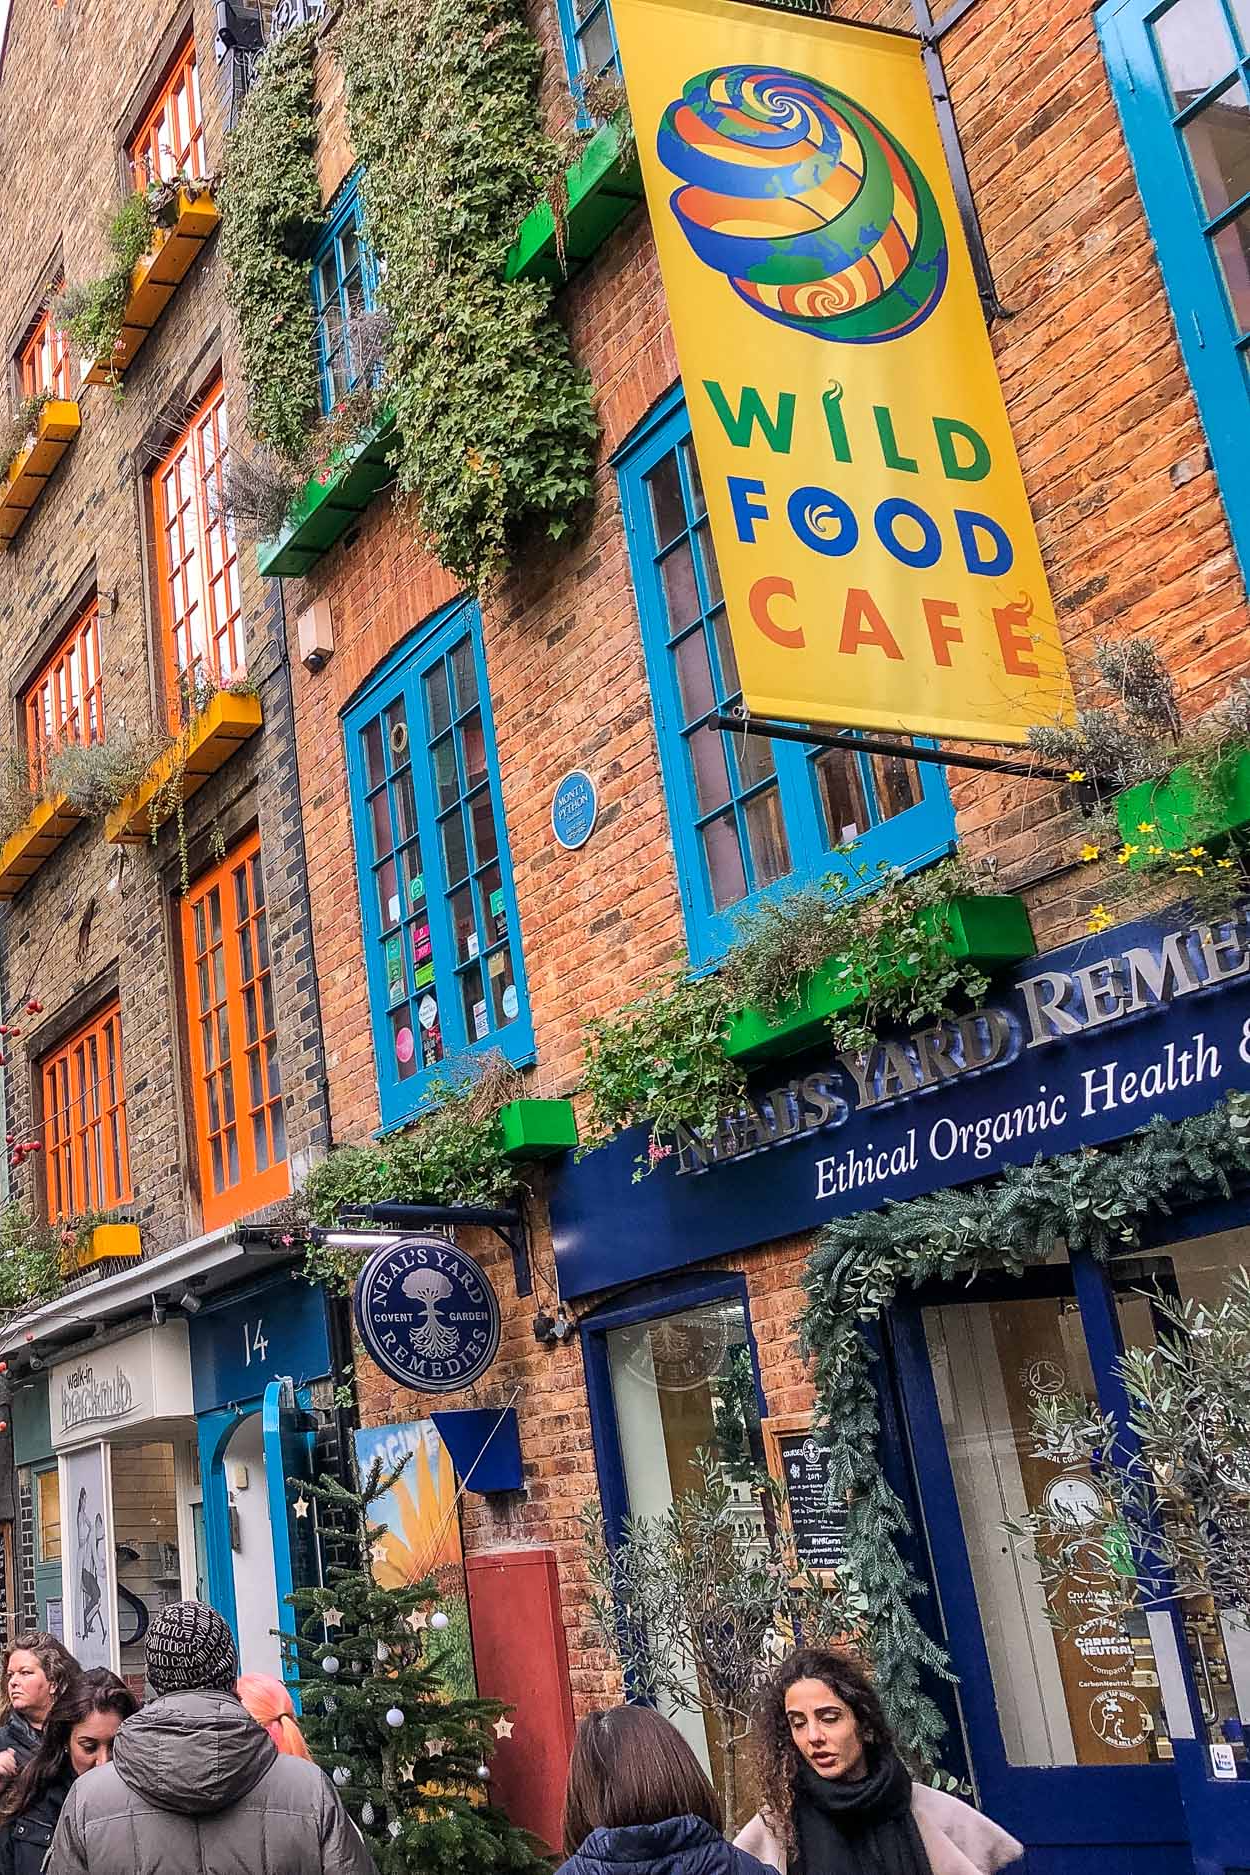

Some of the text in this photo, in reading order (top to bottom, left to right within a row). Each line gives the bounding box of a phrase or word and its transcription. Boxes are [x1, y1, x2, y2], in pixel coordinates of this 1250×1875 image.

[702, 379, 992, 482] WILD
[726, 475, 1014, 578] FOOD
[558, 782, 585, 808] MONTY
[558, 794, 588, 820] PYTHON
[837, 1008, 1012, 1112] YARD
[814, 1131, 919, 1200] Ethical
[928, 1086, 1067, 1160] Organic
[1080, 1033, 1222, 1117] Health
[373, 1249, 484, 1307] NEAL'S YARD
[374, 1311, 488, 1323] COVENT GARDEN
[243, 1320, 269, 1367] 14
[381, 1328, 487, 1377] REMEDIES
[67, 1363, 93, 1389] walk-in
[1080, 1646, 1135, 1657] NEUTRAL
[1093, 1664, 1127, 1676] company
